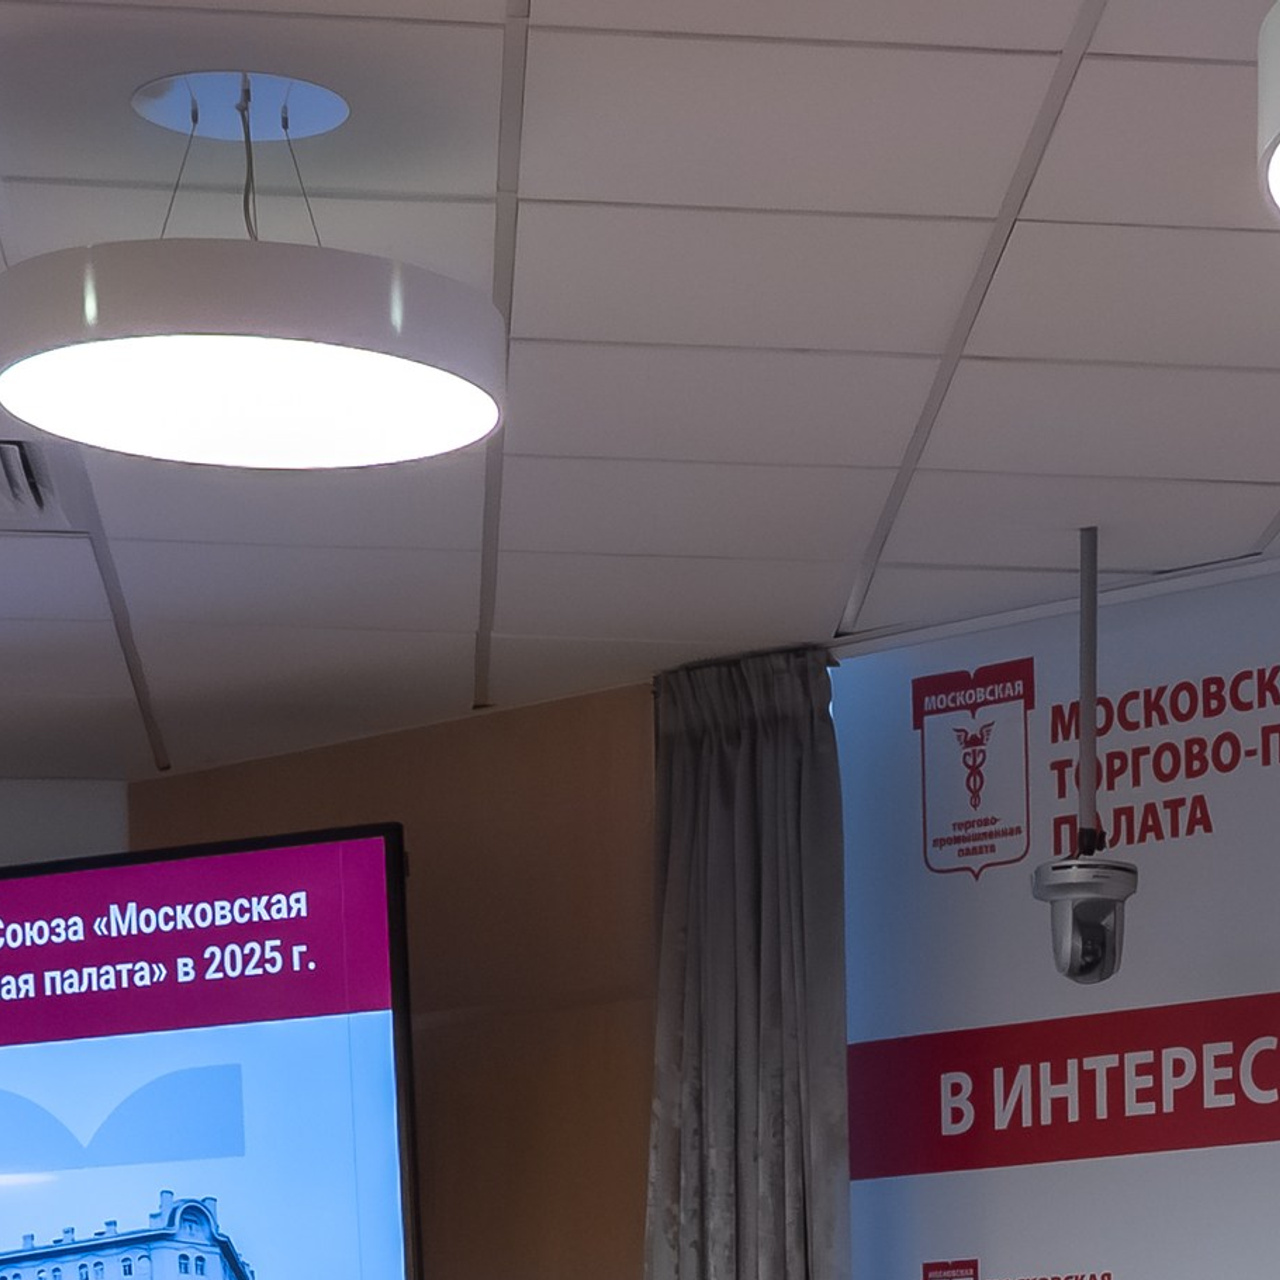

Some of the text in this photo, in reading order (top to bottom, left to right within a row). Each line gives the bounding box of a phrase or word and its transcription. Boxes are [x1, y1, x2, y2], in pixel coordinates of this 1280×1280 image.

[923, 680, 1024, 711] МОСКОВСКАЯ
[1053, 794, 1214, 859] ПЛАТА
[0, 891, 308, 950] оюза «Московская
[44, 960, 168, 997] палата»
[177, 957, 195, 983] в
[204, 939, 283, 980] 2025
[292, 945, 316, 971] г.
[941, 1072, 975, 1137] В
